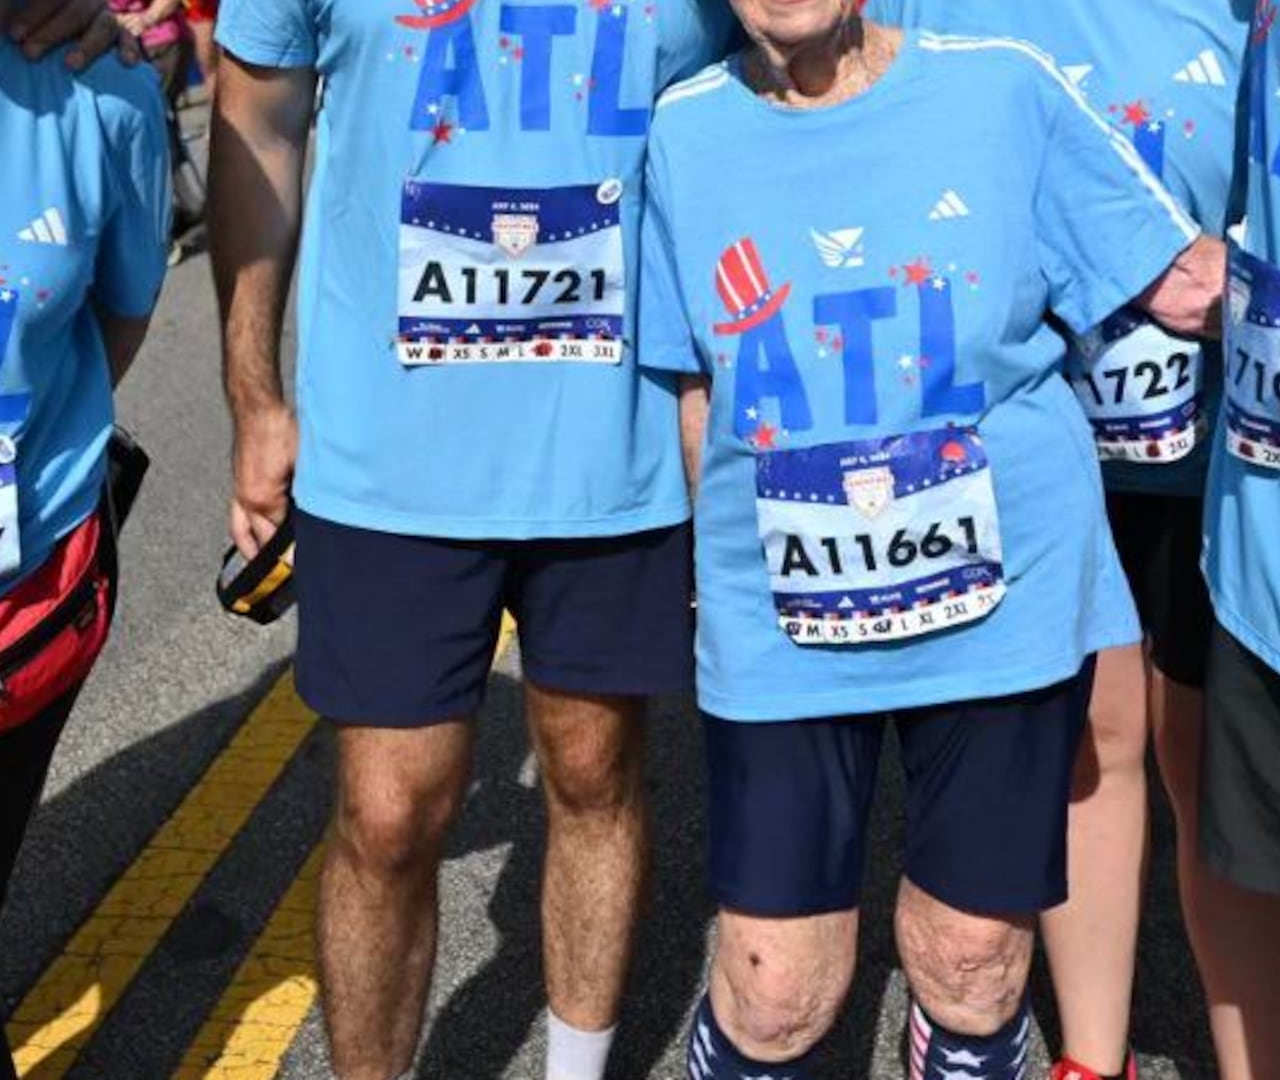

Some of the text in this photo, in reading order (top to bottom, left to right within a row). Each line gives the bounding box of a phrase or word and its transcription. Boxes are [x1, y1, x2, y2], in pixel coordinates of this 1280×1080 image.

[409, 4, 649, 136] ATL
[412, 261, 608, 306] A11721
[733, 279, 986, 440] ATL
[780, 516, 979, 577] A11661
